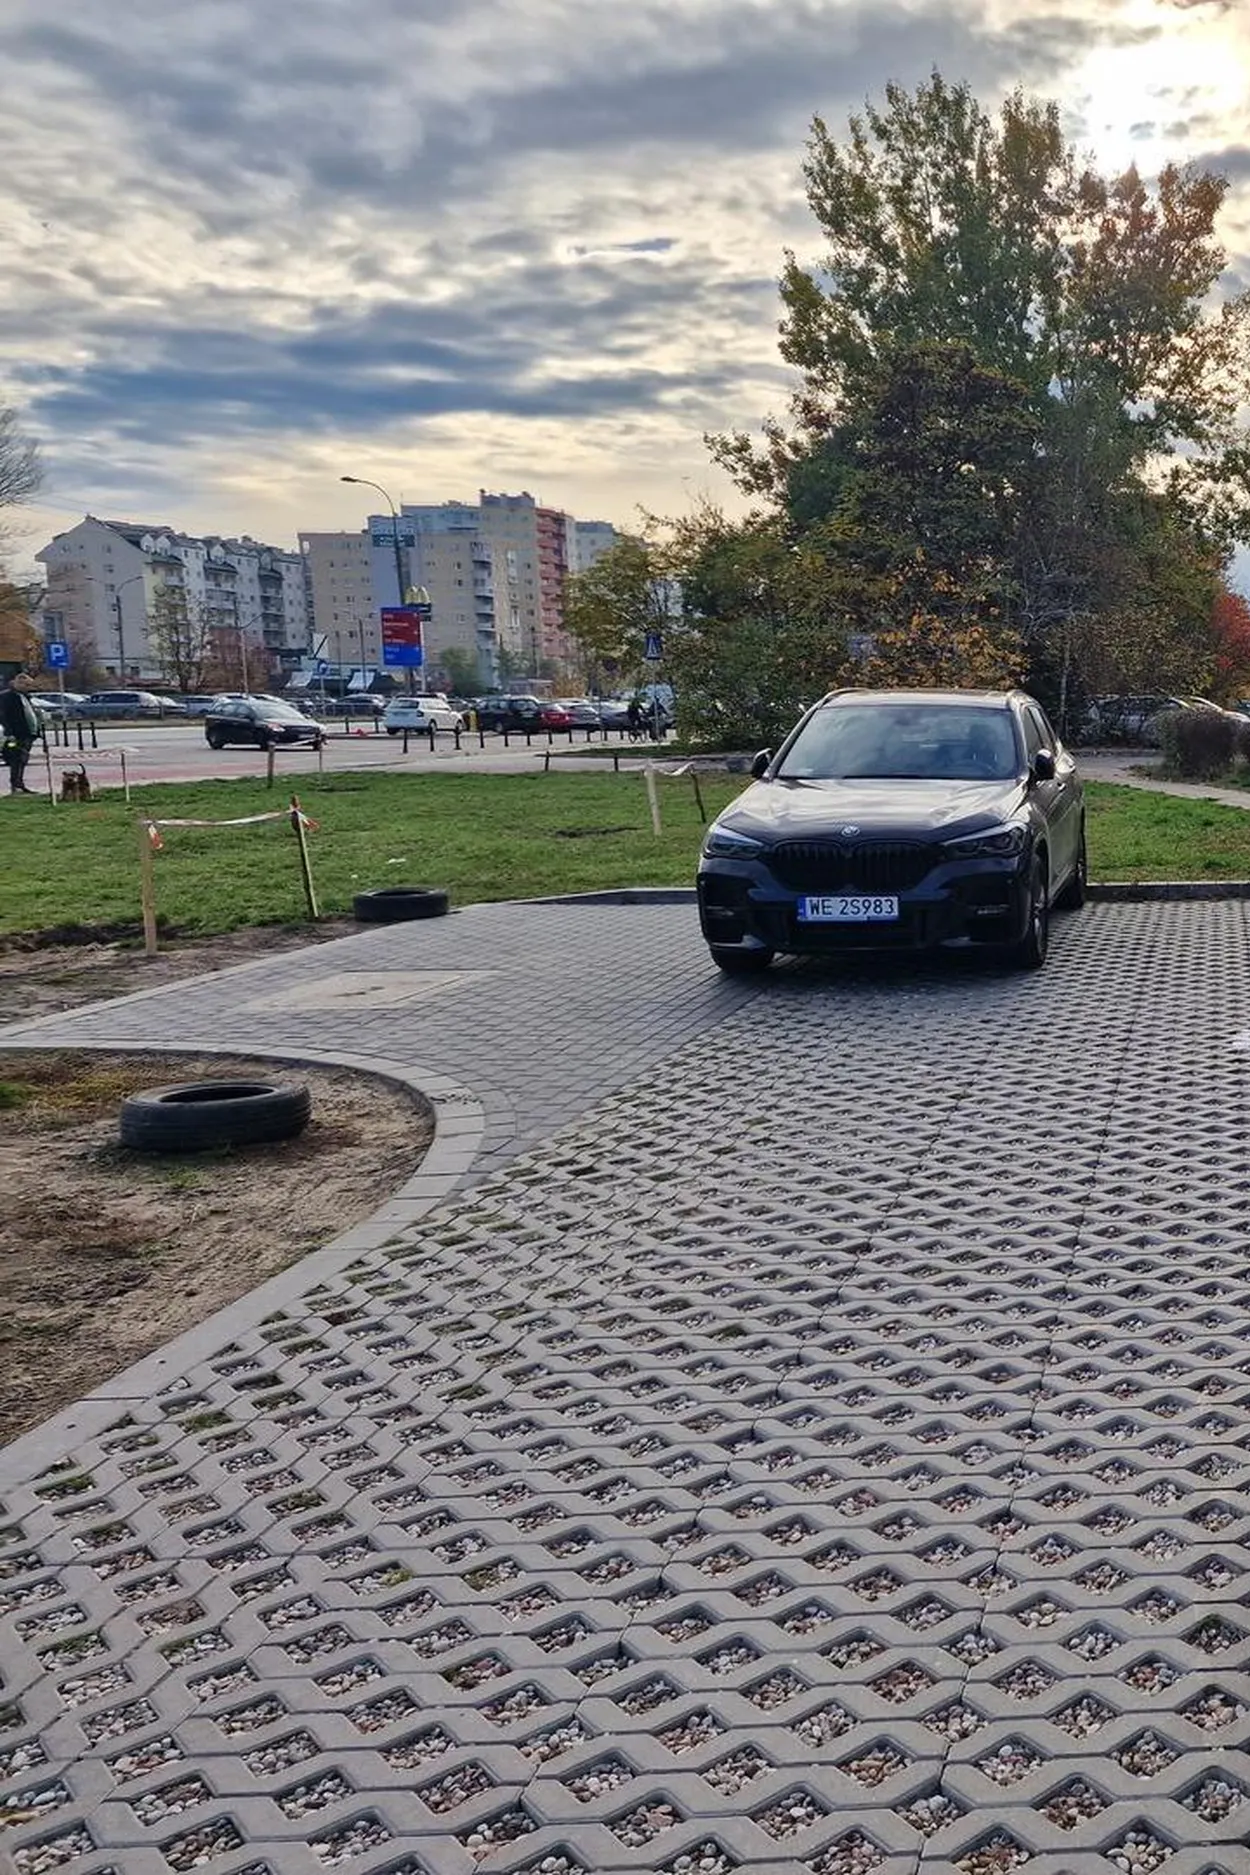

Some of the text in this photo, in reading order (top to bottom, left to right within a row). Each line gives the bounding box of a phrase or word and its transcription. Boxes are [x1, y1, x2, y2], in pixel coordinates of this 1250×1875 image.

[50, 643, 65, 661] P
[808, 898, 894, 916] WE 2S983
